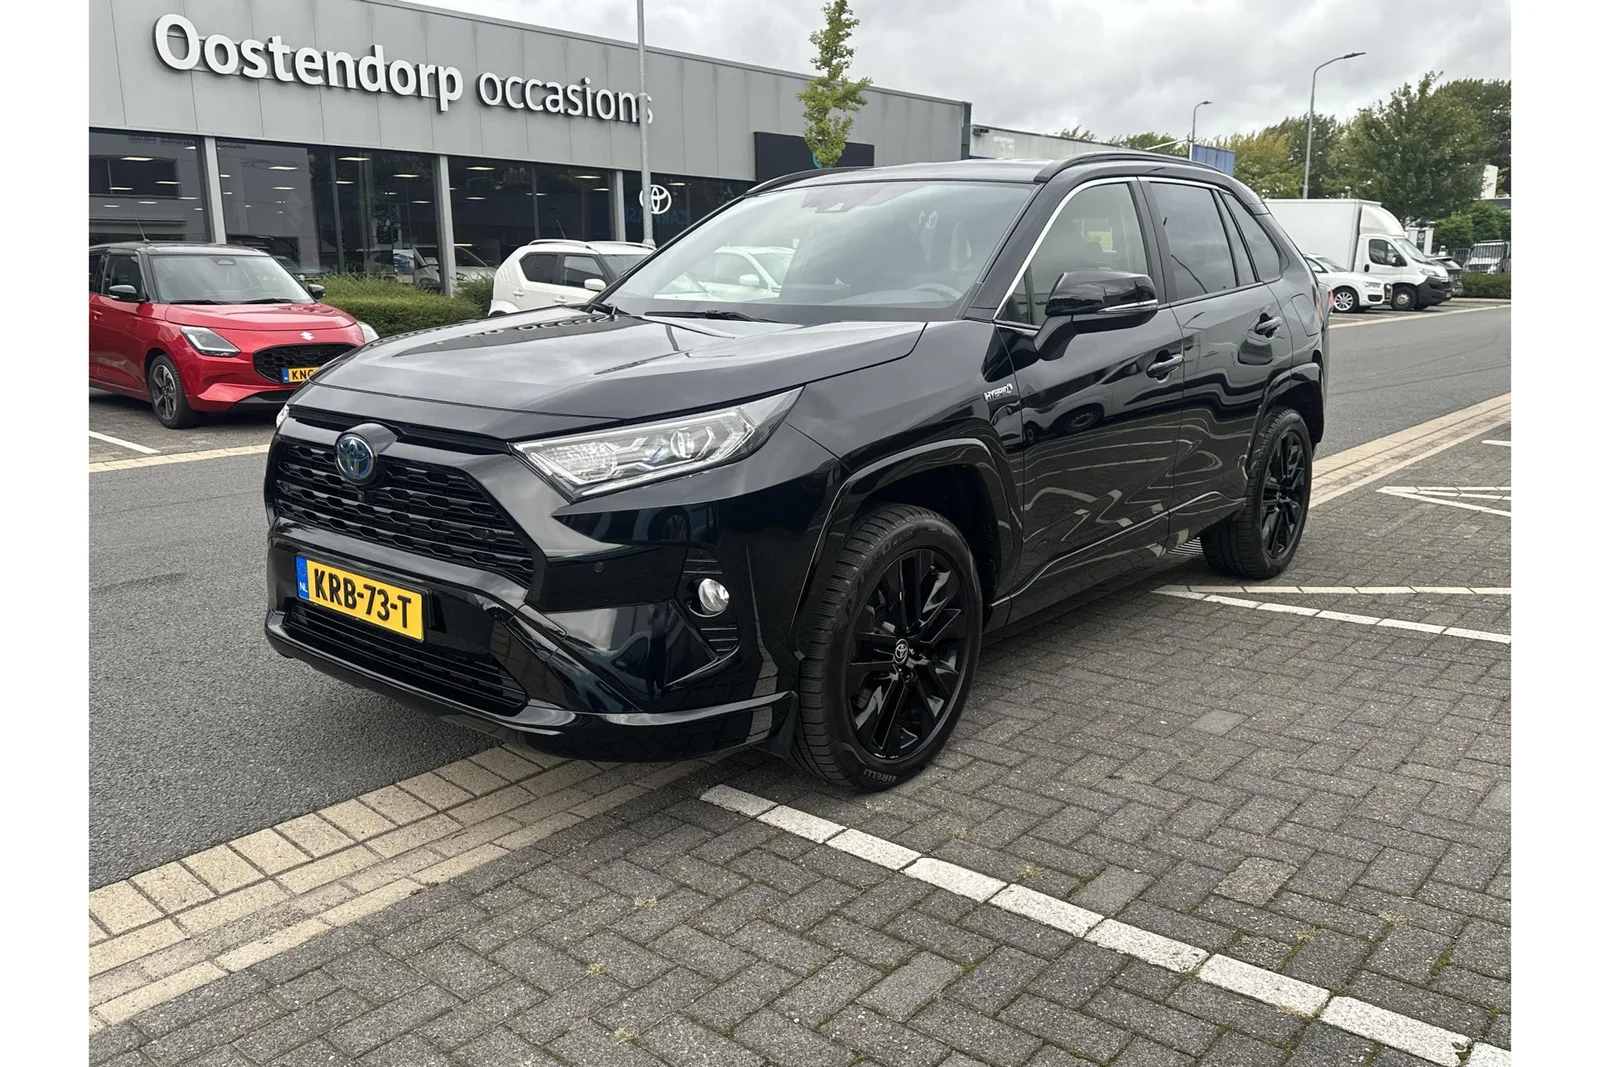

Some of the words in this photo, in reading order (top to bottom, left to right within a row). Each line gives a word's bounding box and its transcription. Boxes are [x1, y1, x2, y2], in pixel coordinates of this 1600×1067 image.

[154, 13, 464, 112] Oostendorp
[299, 581, 309, 593] NL
[314, 567, 412, 629] KRB-73-T
[862, 768, 898, 783] PIRELLI
